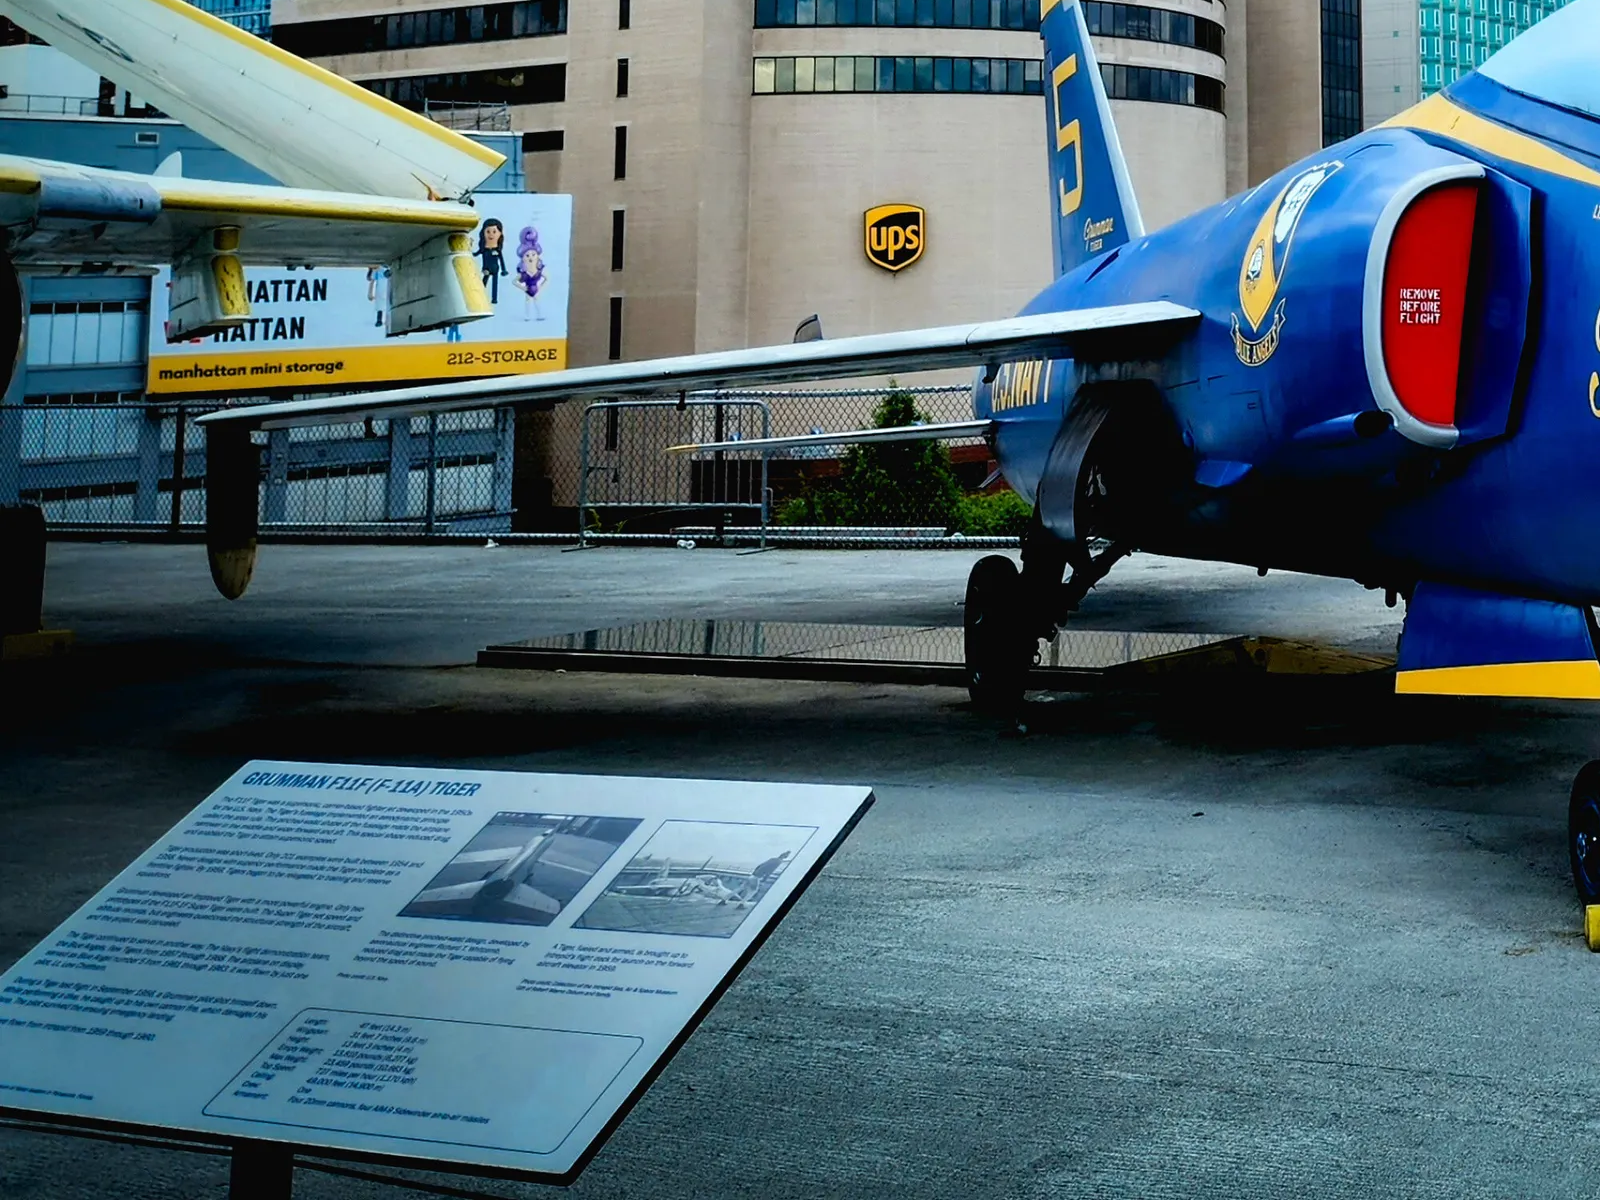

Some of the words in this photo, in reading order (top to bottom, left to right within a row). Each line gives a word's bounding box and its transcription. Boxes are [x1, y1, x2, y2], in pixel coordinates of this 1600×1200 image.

[1052, 53, 1083, 217] 5
[871, 224, 919, 260] ups
[247, 278, 328, 303] ATTAN
[1400, 288, 1441, 299] REMOVE
[1400, 301, 1441, 312] BEFORE
[1400, 312, 1441, 324] FLIGHT
[447, 348, 557, 366] 212-STORAGE
[159, 361, 246, 380] manhattan
[250, 362, 282, 376] mini
[285, 360, 344, 375] storage
[242, 771, 331, 788] GRUMMAN
[325, 776, 374, 791] F11F
[365, 778, 432, 797] (F-11A)
[429, 781, 482, 796] TIGER
